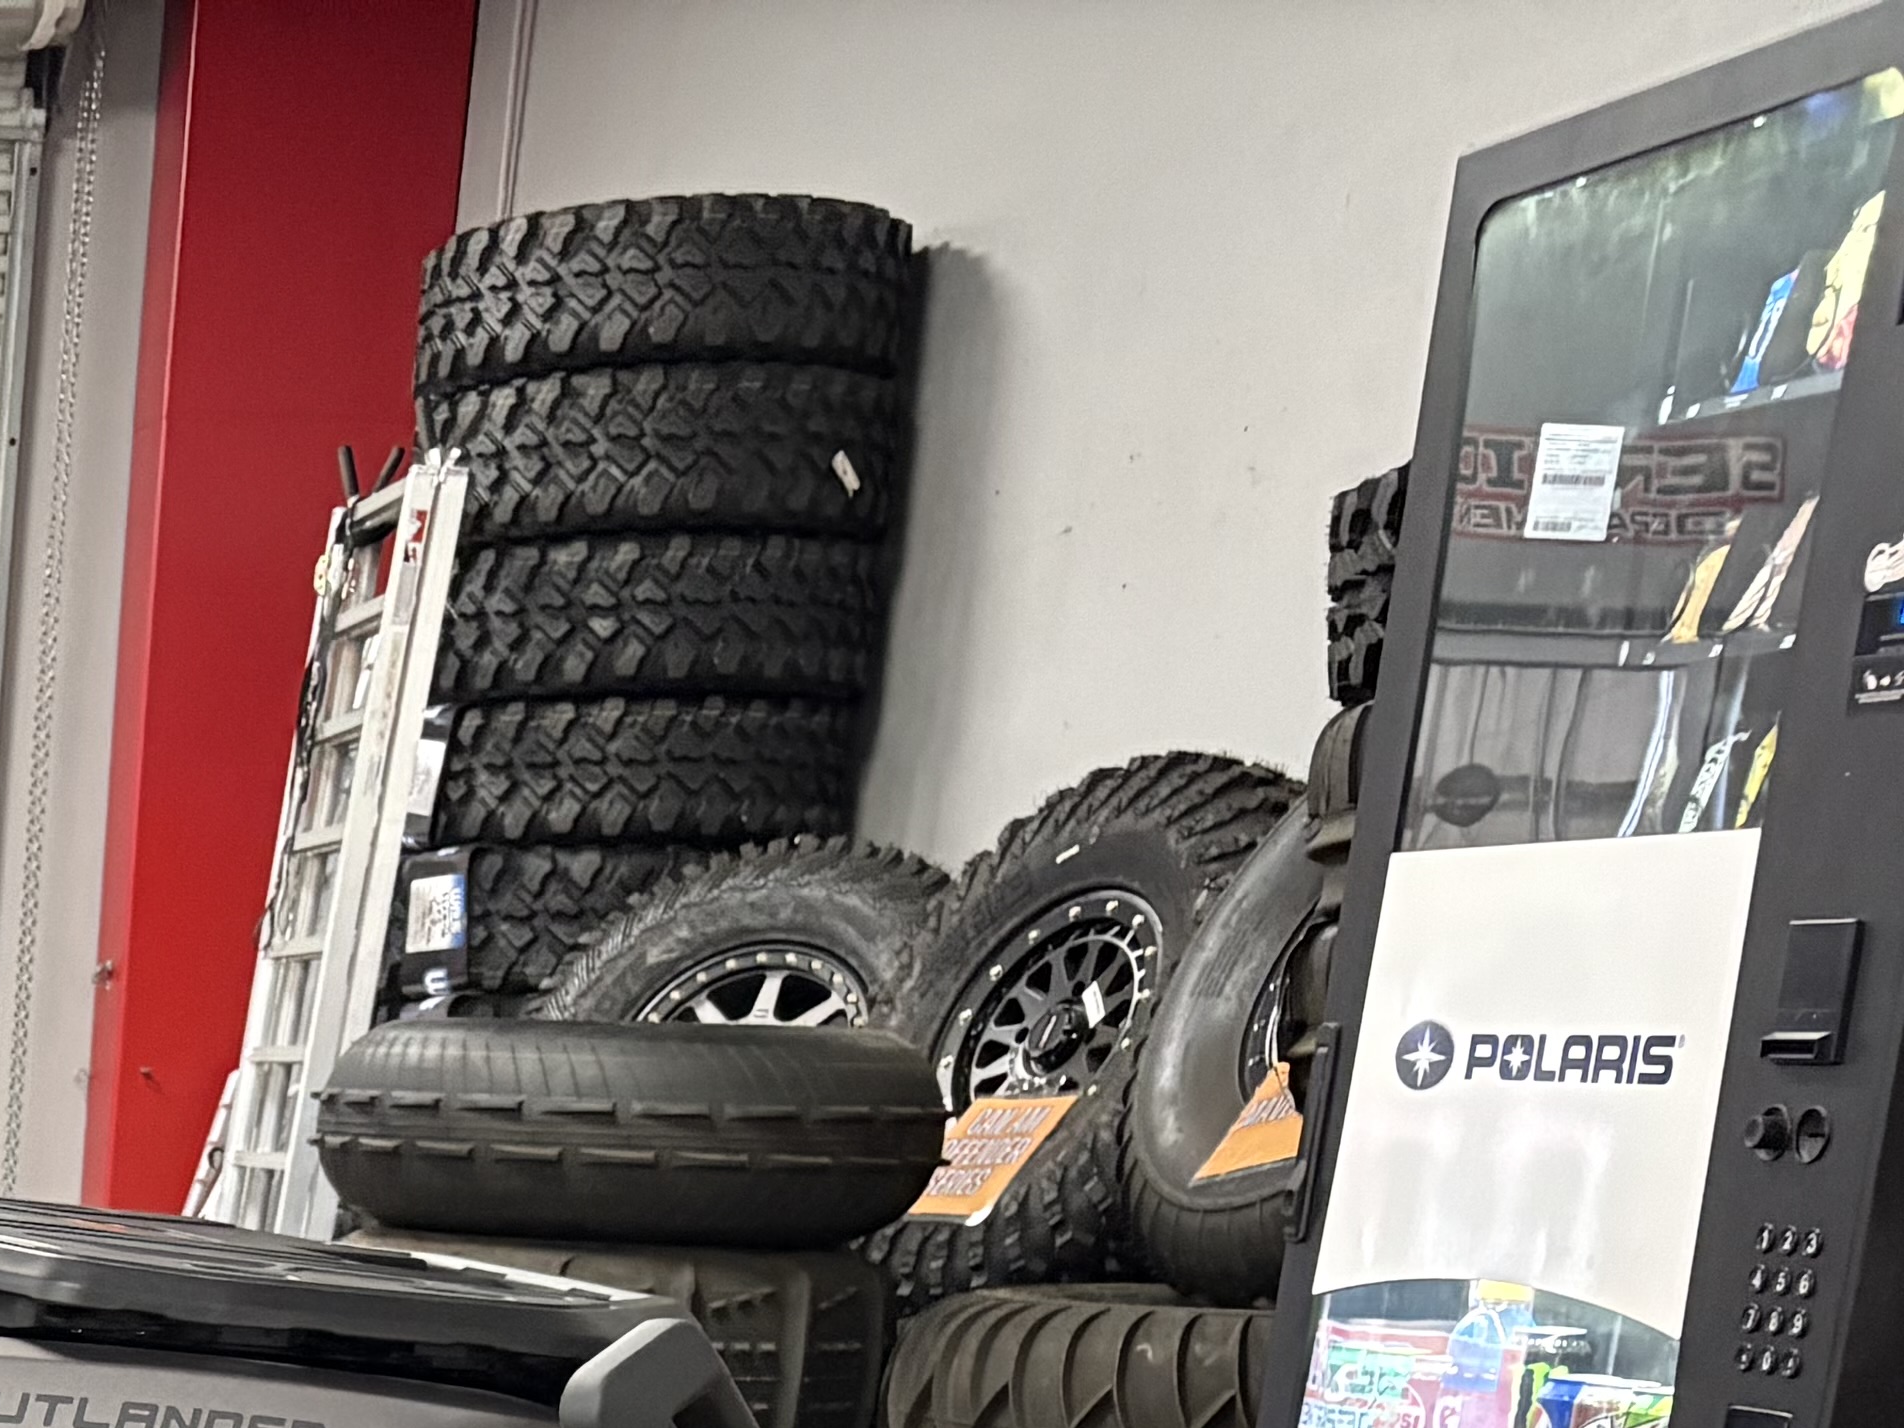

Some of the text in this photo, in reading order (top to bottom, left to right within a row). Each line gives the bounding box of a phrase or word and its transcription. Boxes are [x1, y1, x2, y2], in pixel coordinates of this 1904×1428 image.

[1463, 1033, 1678, 1086] POLARIS
[1805, 1231, 1818, 1254] 3
[1775, 1271, 1786, 1292] 5
[1798, 1272, 1809, 1295] 6
[1768, 1310, 1779, 1332] 8
[1791, 1312, 1803, 1335] 9
